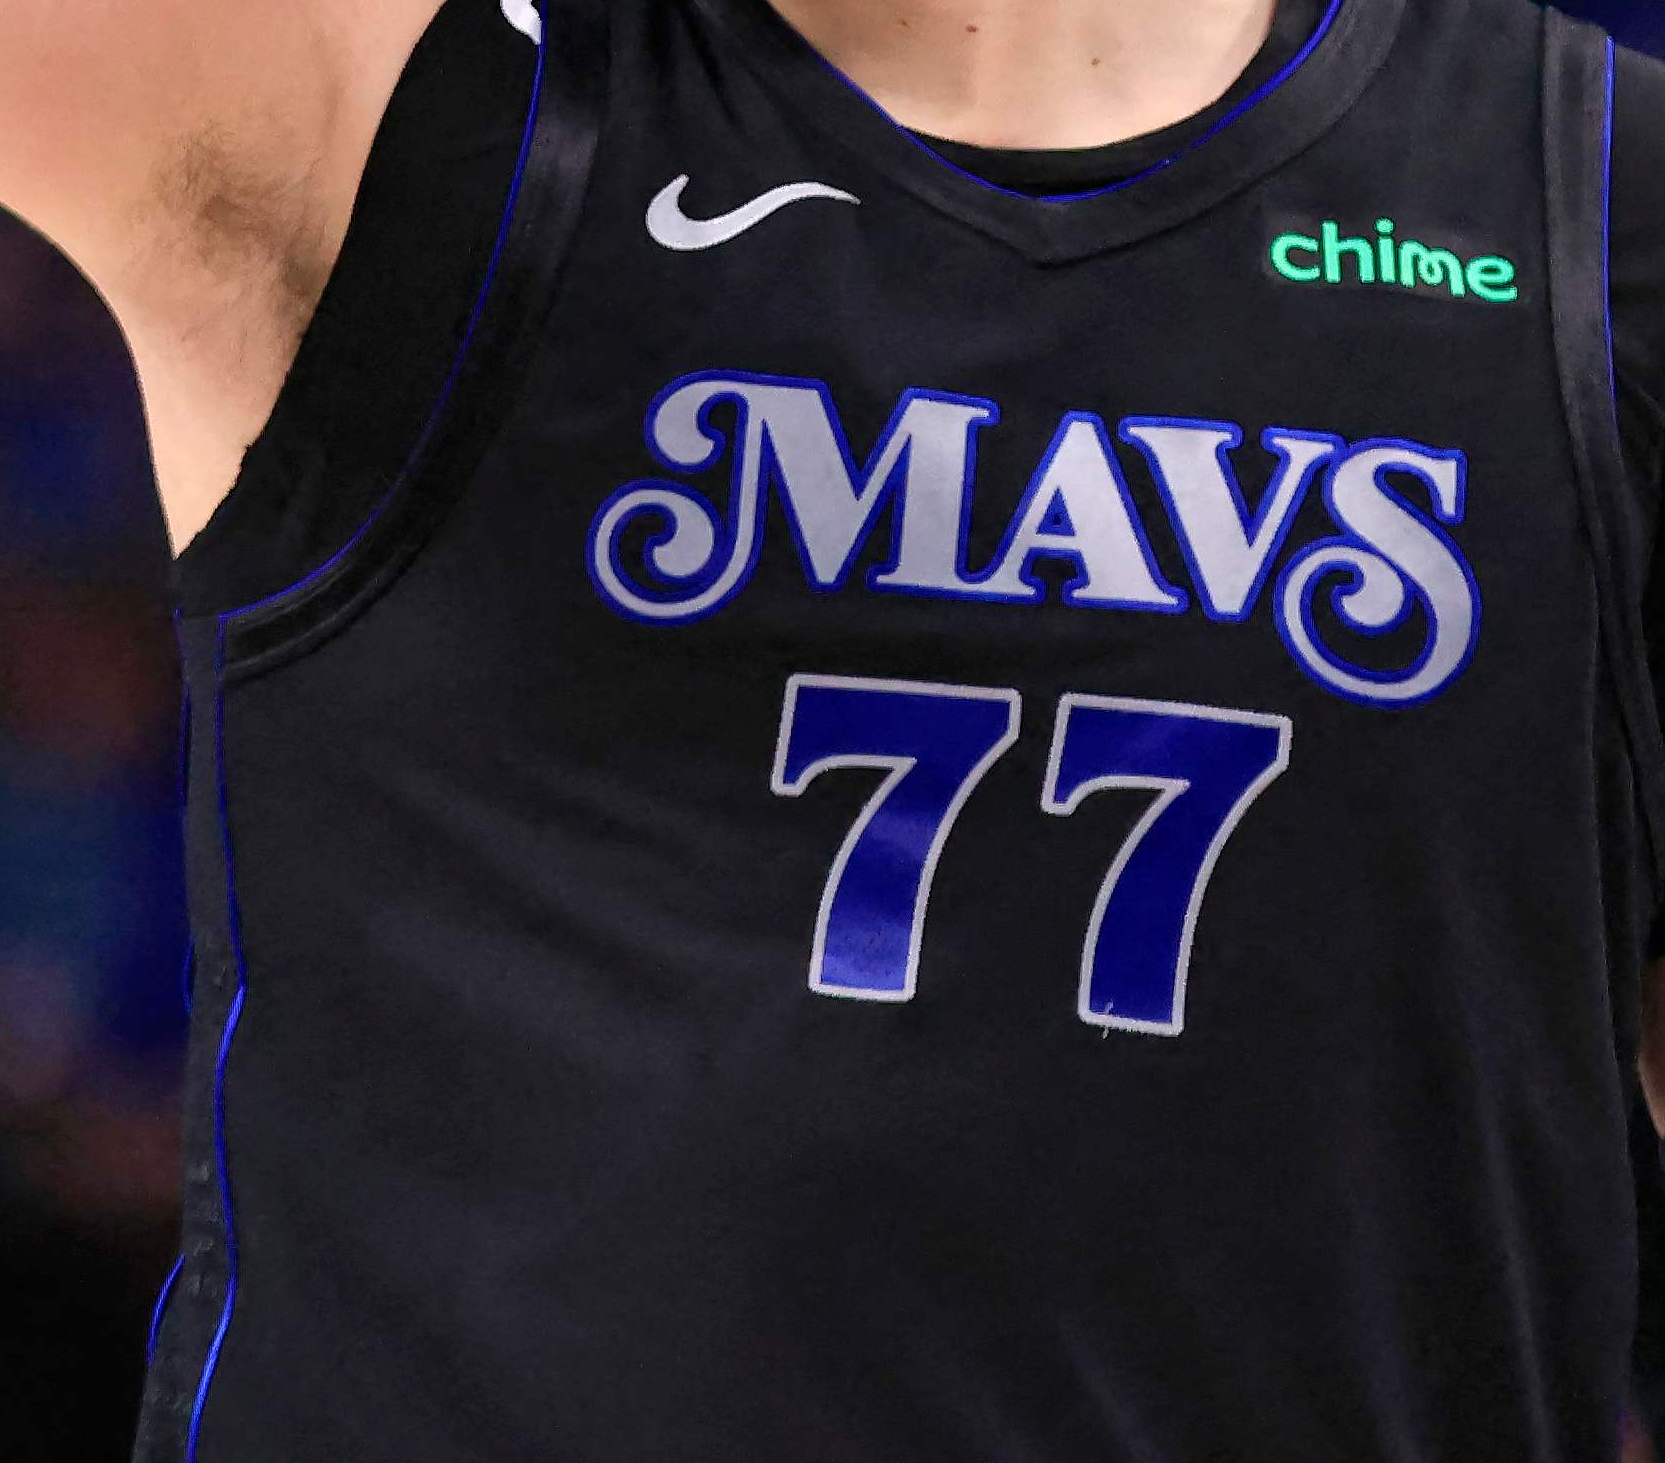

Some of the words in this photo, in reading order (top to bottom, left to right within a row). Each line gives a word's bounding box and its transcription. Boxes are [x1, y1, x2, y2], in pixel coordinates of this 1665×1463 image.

[1269, 217, 1519, 303] chime
[587, 369, 1483, 709] MAVS
[770, 674, 1294, 1036] 77
